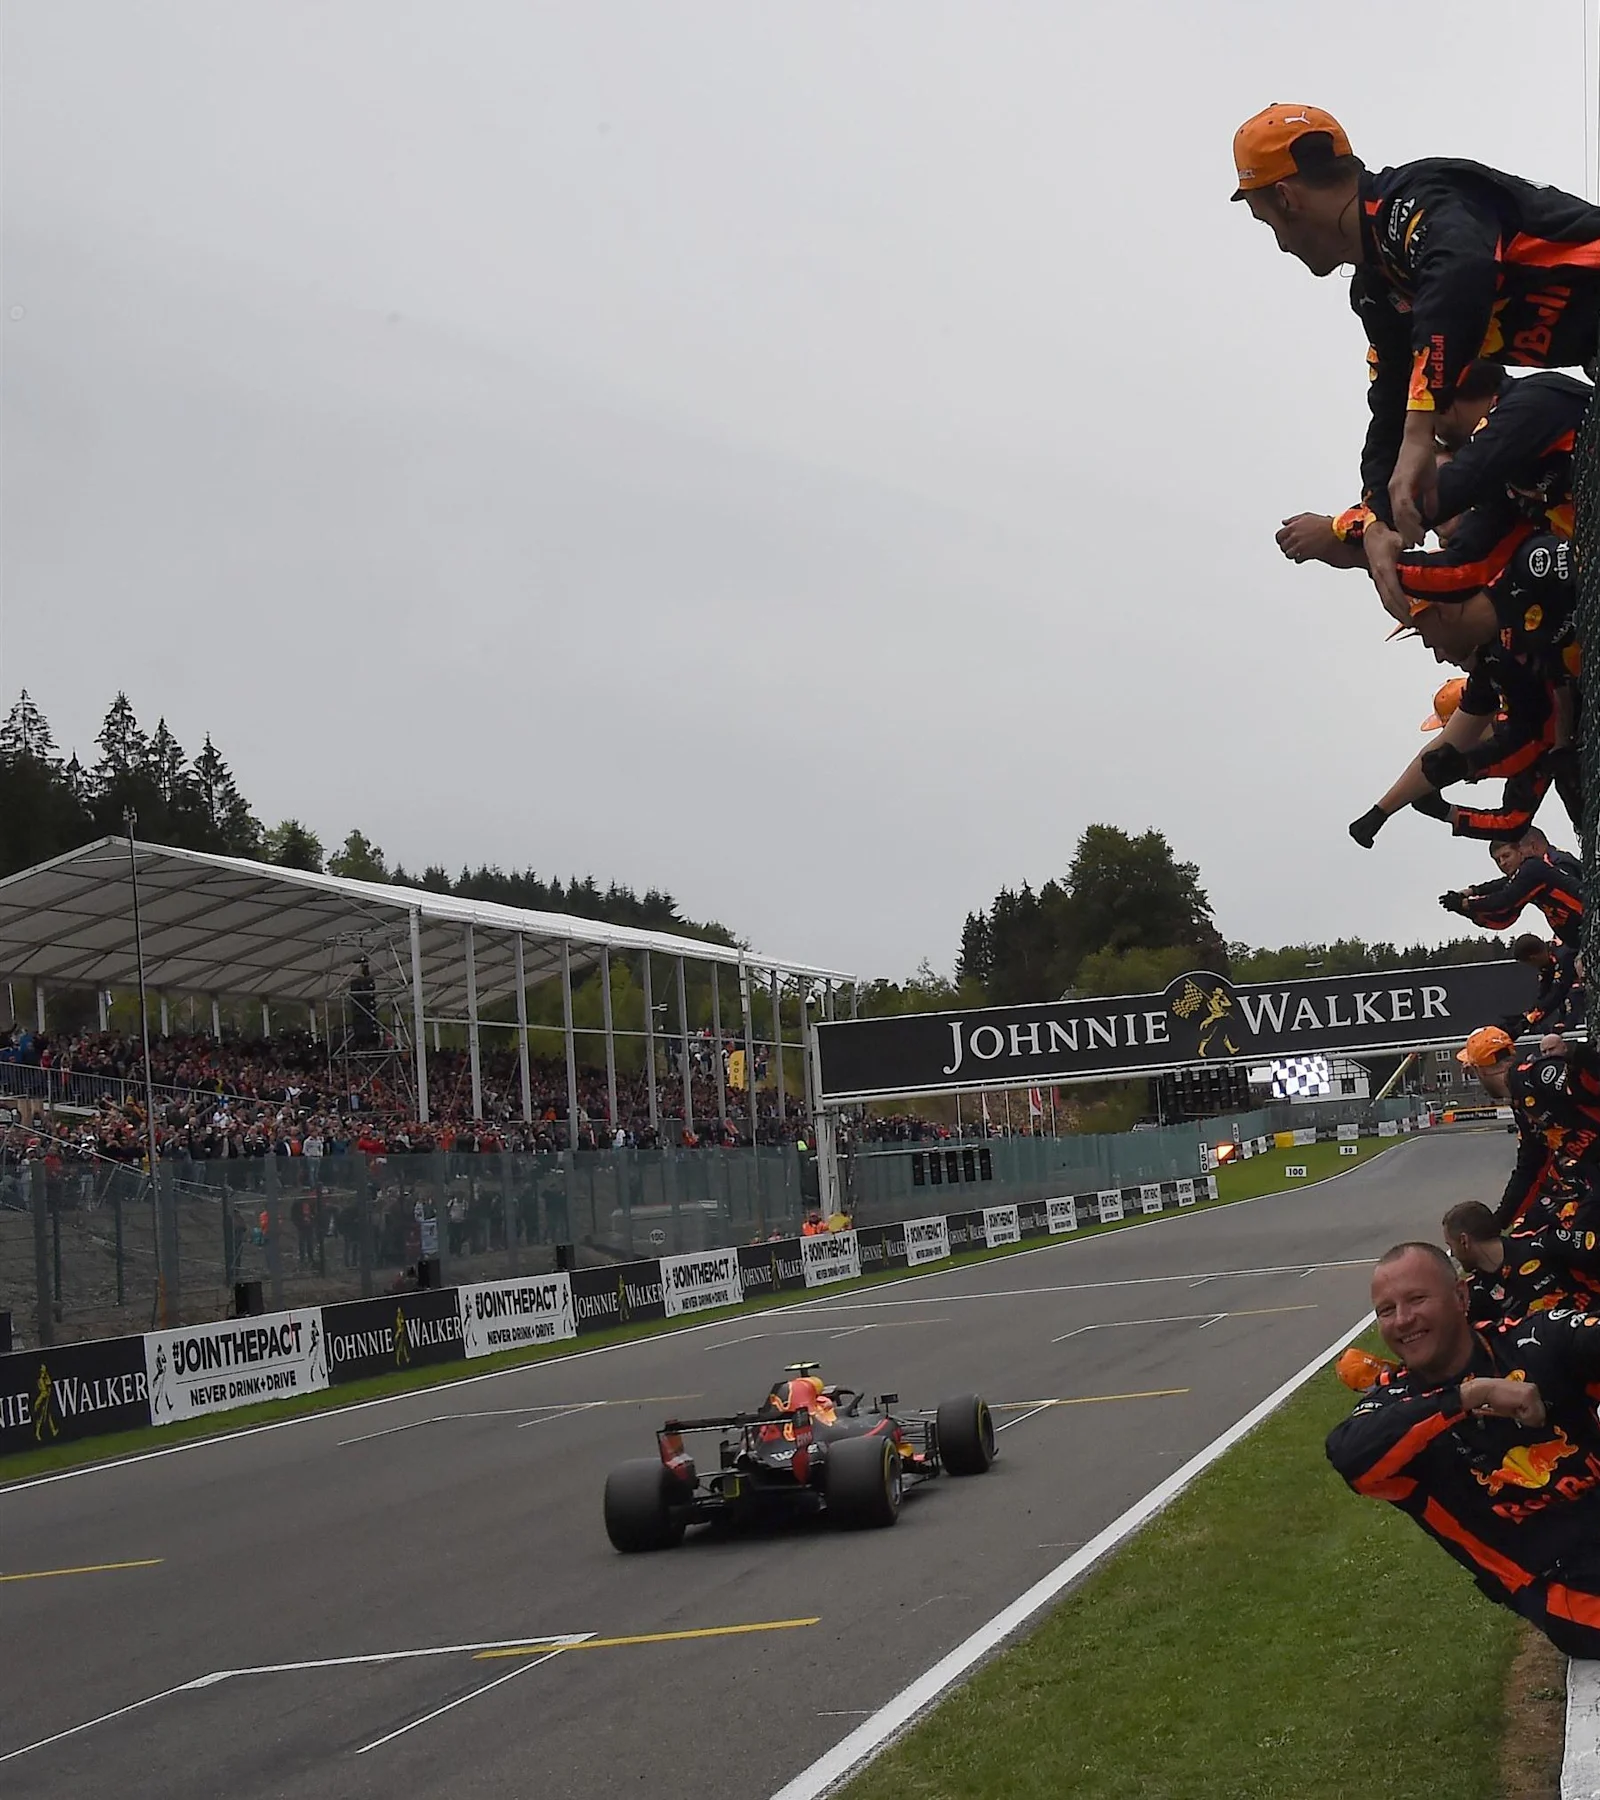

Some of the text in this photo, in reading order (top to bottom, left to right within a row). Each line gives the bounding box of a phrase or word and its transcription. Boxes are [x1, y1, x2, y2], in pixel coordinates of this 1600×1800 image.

[1431, 335, 1444, 388] Red Bull
[943, 986, 1450, 1076] JOHNNIE WALKER
[1200, 1144, 1208, 1171] 150
[740, 1264, 772, 1292] JOHNNIE
[573, 1282, 664, 1326] JOHNNIE WALKER
[172, 1322, 302, 1375] #JOINTHEPACT
[326, 1315, 462, 1373] JOHNNIE WALKER
[487, 1329, 511, 1345] NEVER
[53, 1371, 148, 1418] WALKER
[190, 1383, 227, 1406] NEVER
